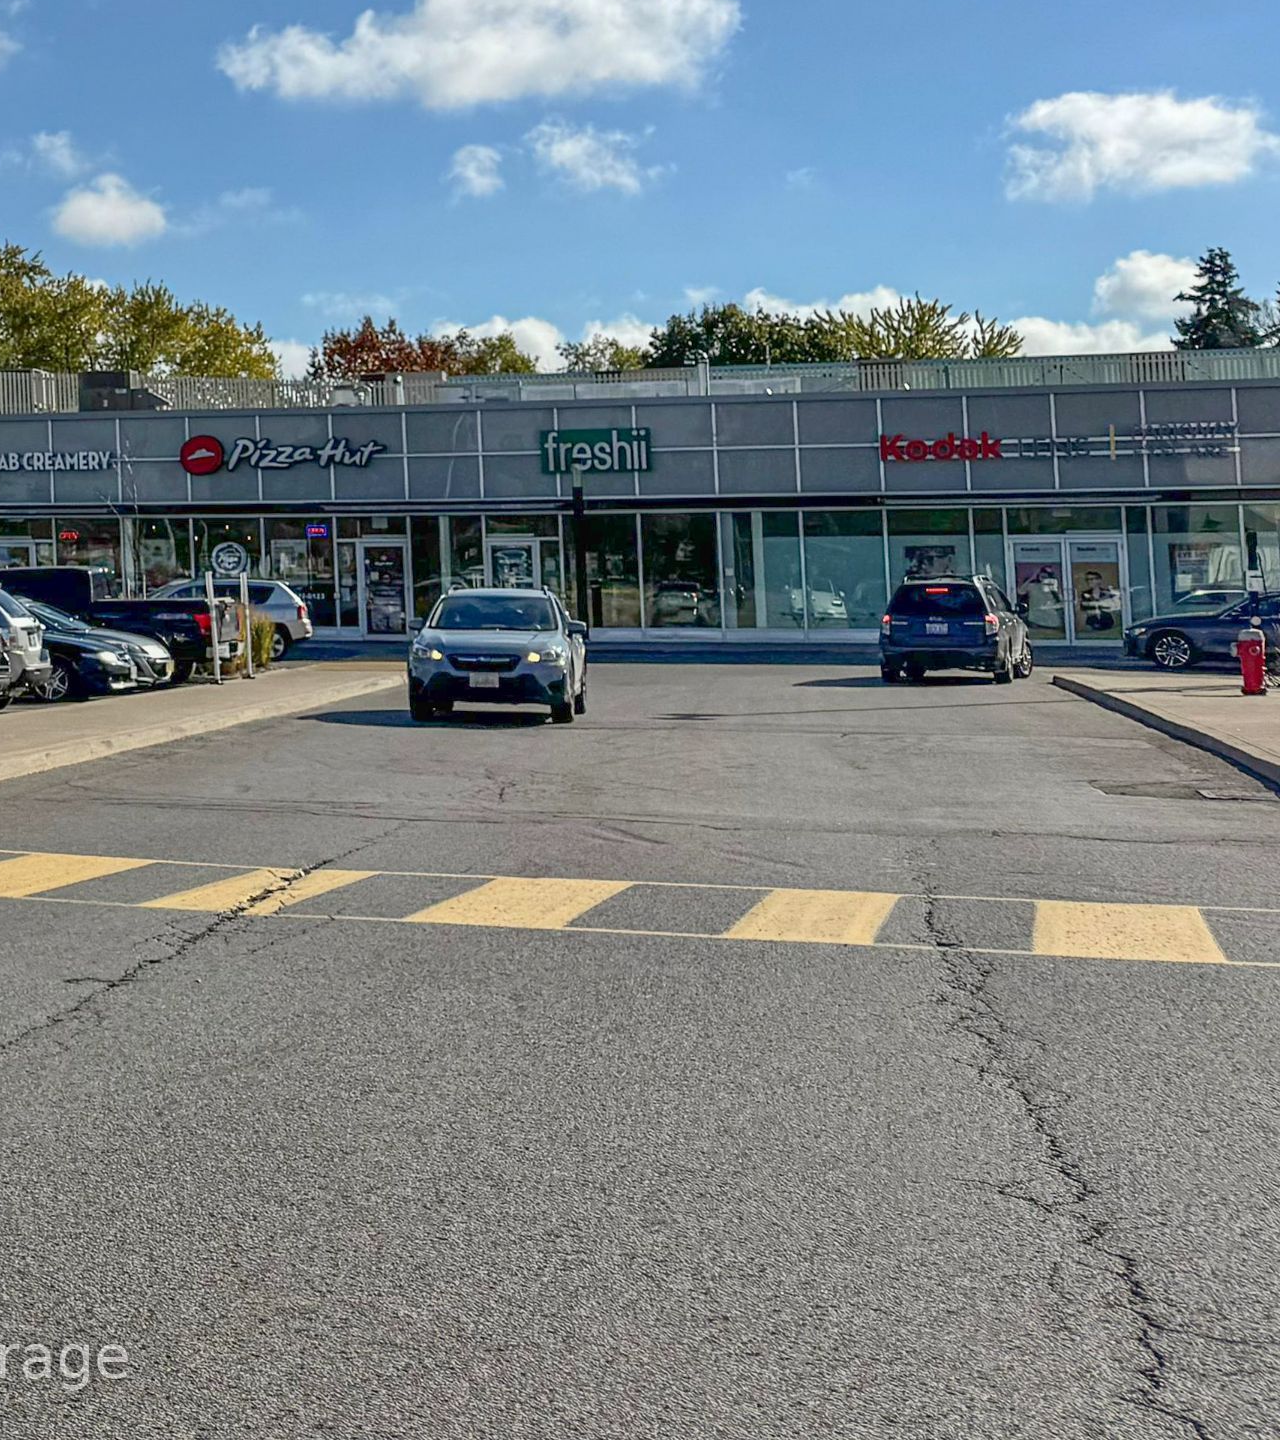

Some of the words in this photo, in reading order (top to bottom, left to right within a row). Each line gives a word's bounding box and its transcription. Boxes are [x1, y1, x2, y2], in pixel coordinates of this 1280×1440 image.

[23, 451, 111, 471] CREAMERY
[227, 439, 314, 471] Pizza
[316, 439, 384, 467] Hut
[544, 430, 647, 471] freshii
[880, 432, 1003, 460] Kodak
